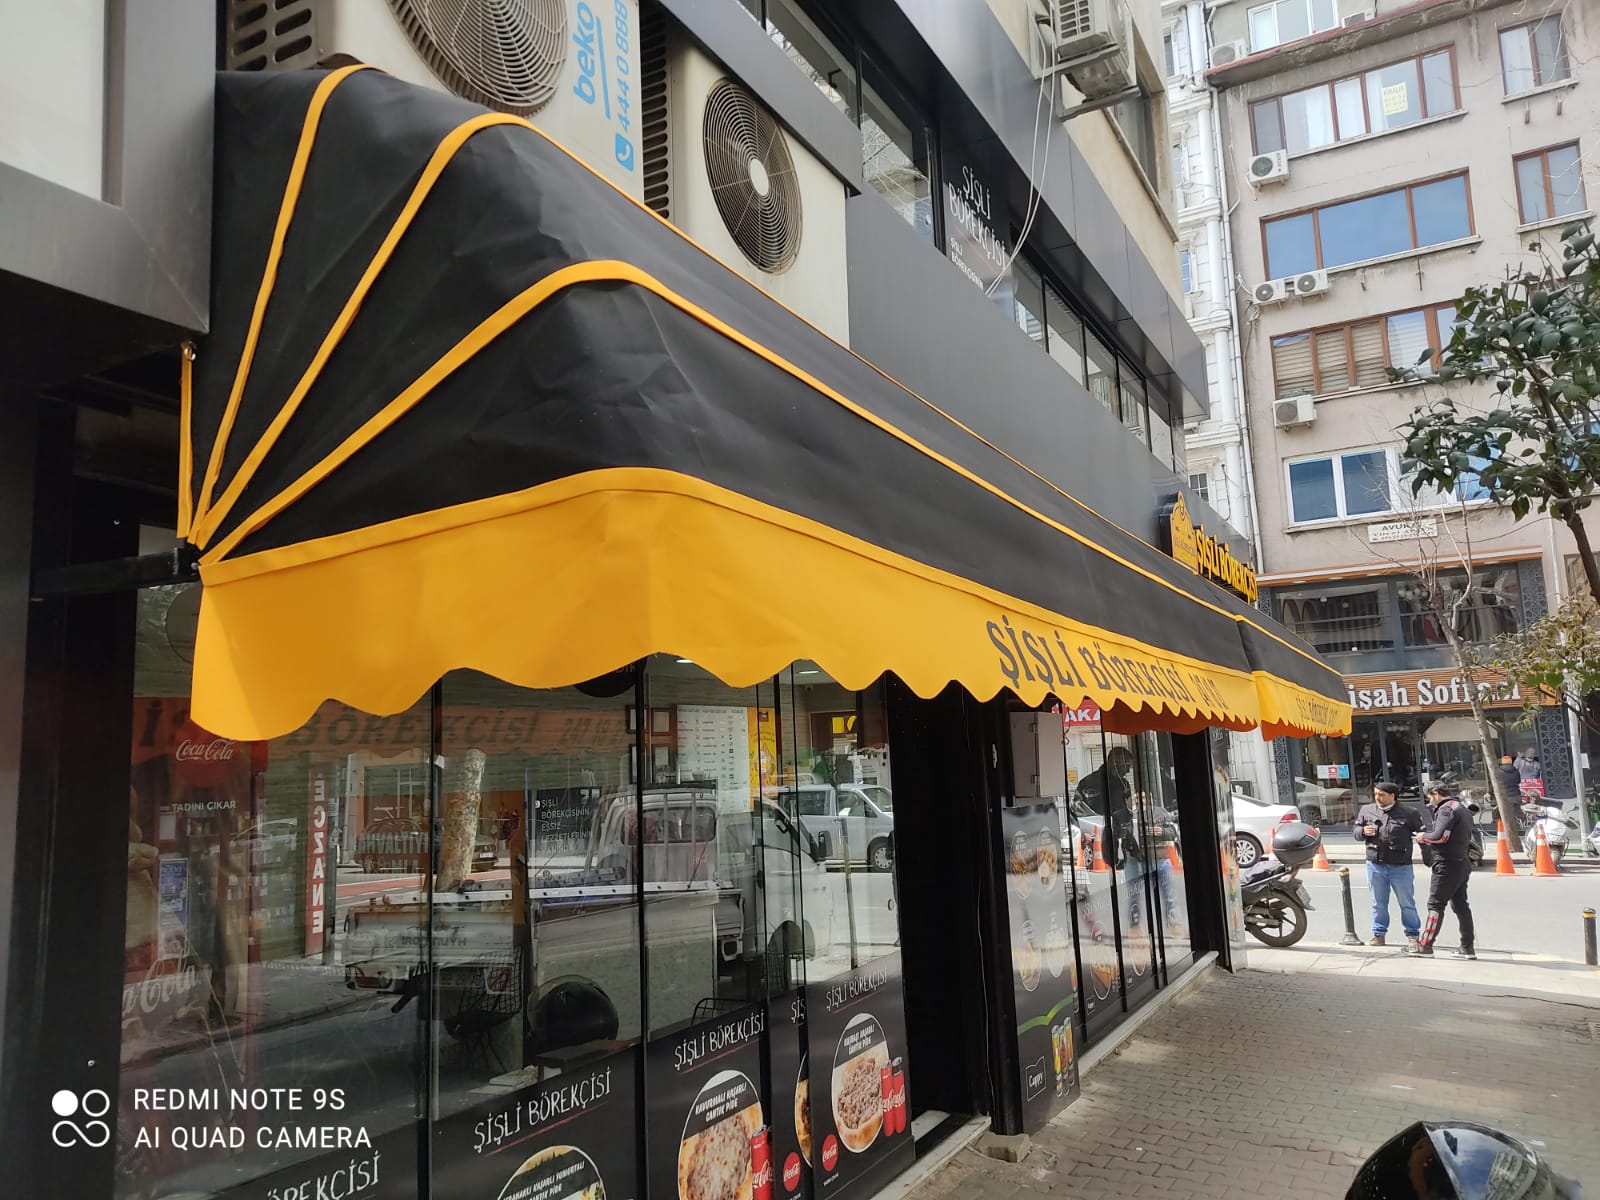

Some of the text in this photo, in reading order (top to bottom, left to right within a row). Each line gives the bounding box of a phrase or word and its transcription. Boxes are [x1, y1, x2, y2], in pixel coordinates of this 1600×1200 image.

[573, 1, 596, 105] beko
[617, 78, 631, 132] 444
[986, 614, 1087, 692] ŞİŞLİ
[1077, 641, 1196, 706] BÖREKÇİSİ
[1417, 676, 1521, 706] Sofraı
[176, 738, 237, 761] Coca-Cola
[791, 996, 806, 1024] ŞİŞ
[825, 967, 888, 1012] ŞİŞLİ BÖREKÇİSİ
[674, 1008, 764, 1071] ŞİŞLİ BÖREKÇİSİ
[474, 1065, 612, 1154] ŞİŞLİ BÖREKÇİSİ
[267, 1149, 381, 1200] EKÇİSİ
